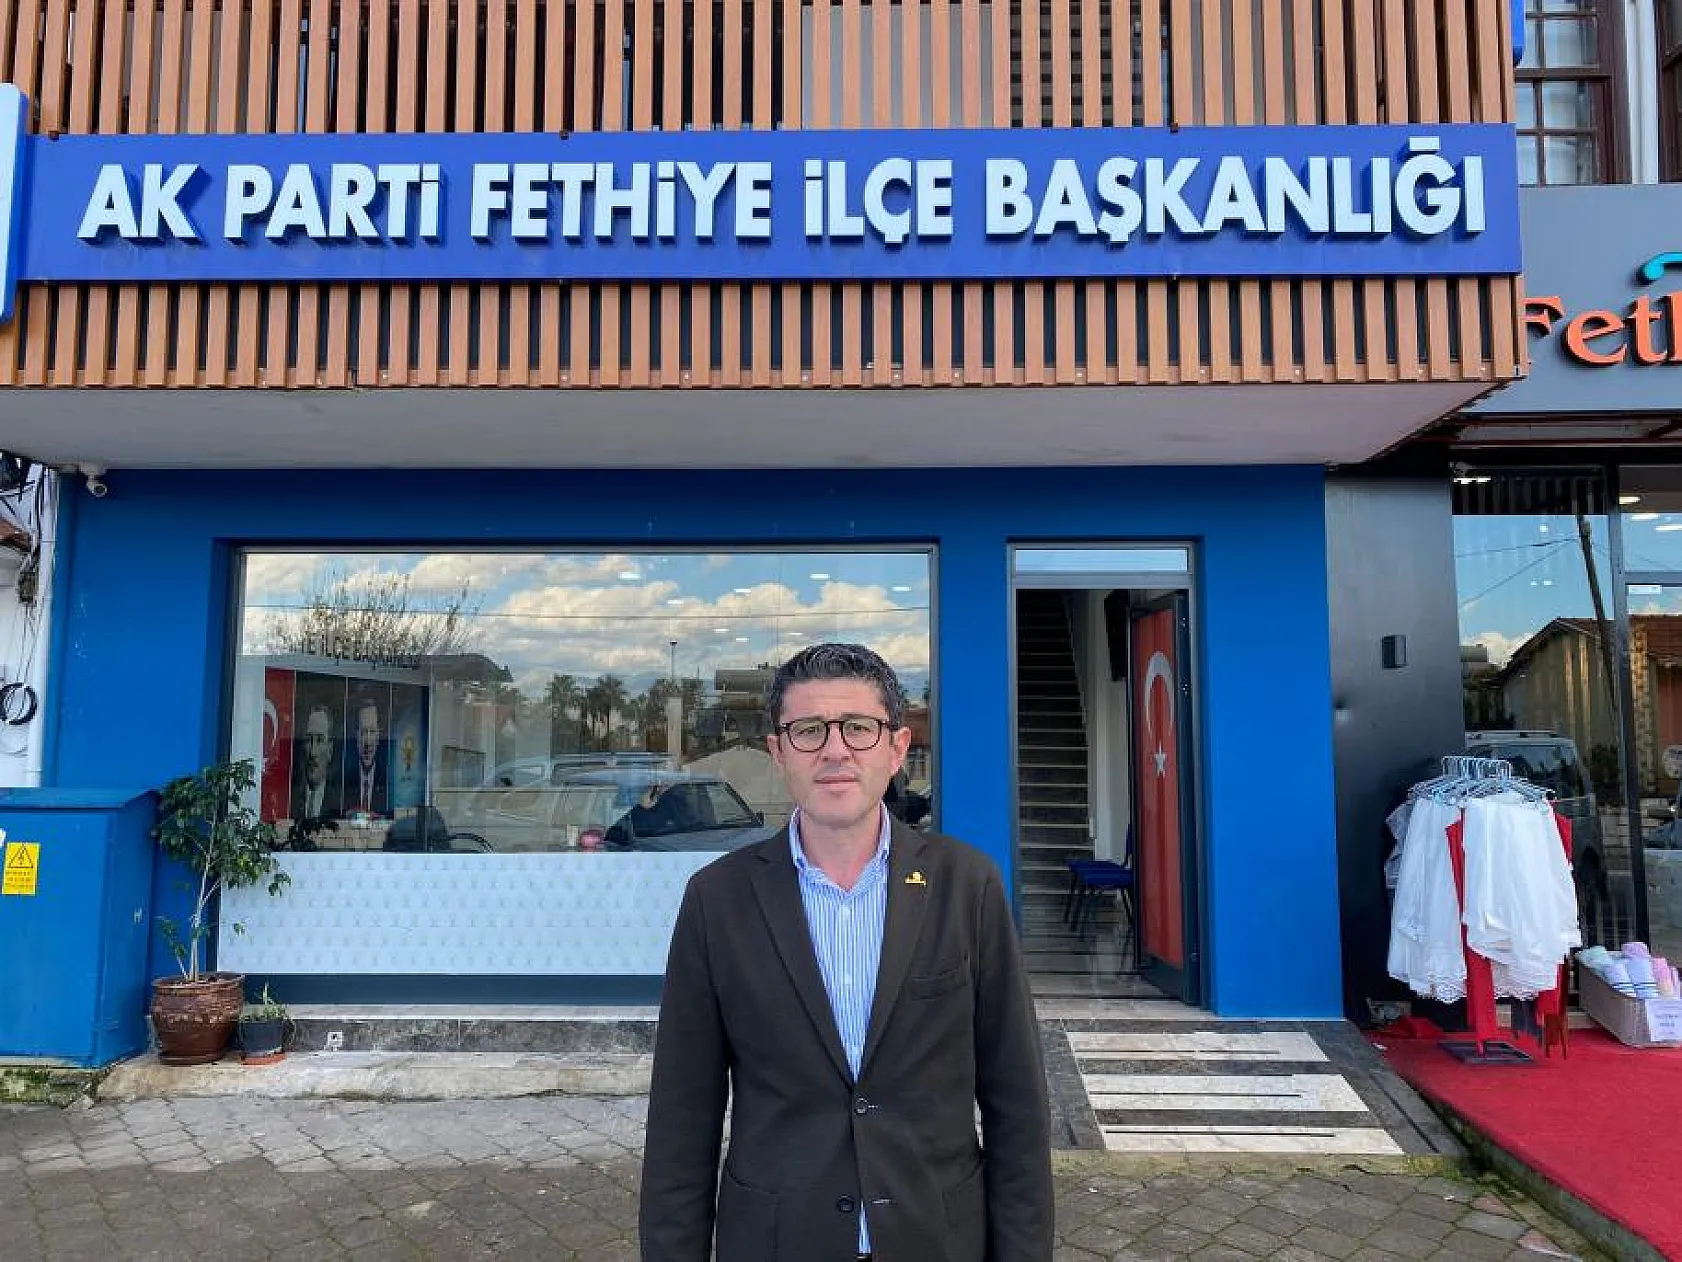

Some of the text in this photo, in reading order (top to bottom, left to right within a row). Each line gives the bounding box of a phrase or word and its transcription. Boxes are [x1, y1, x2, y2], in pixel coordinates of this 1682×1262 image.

[77, 163, 198, 238] AK
[805, 157, 954, 242] İLÇE
[986, 135, 1486, 242] BAŞKANLIĞI
